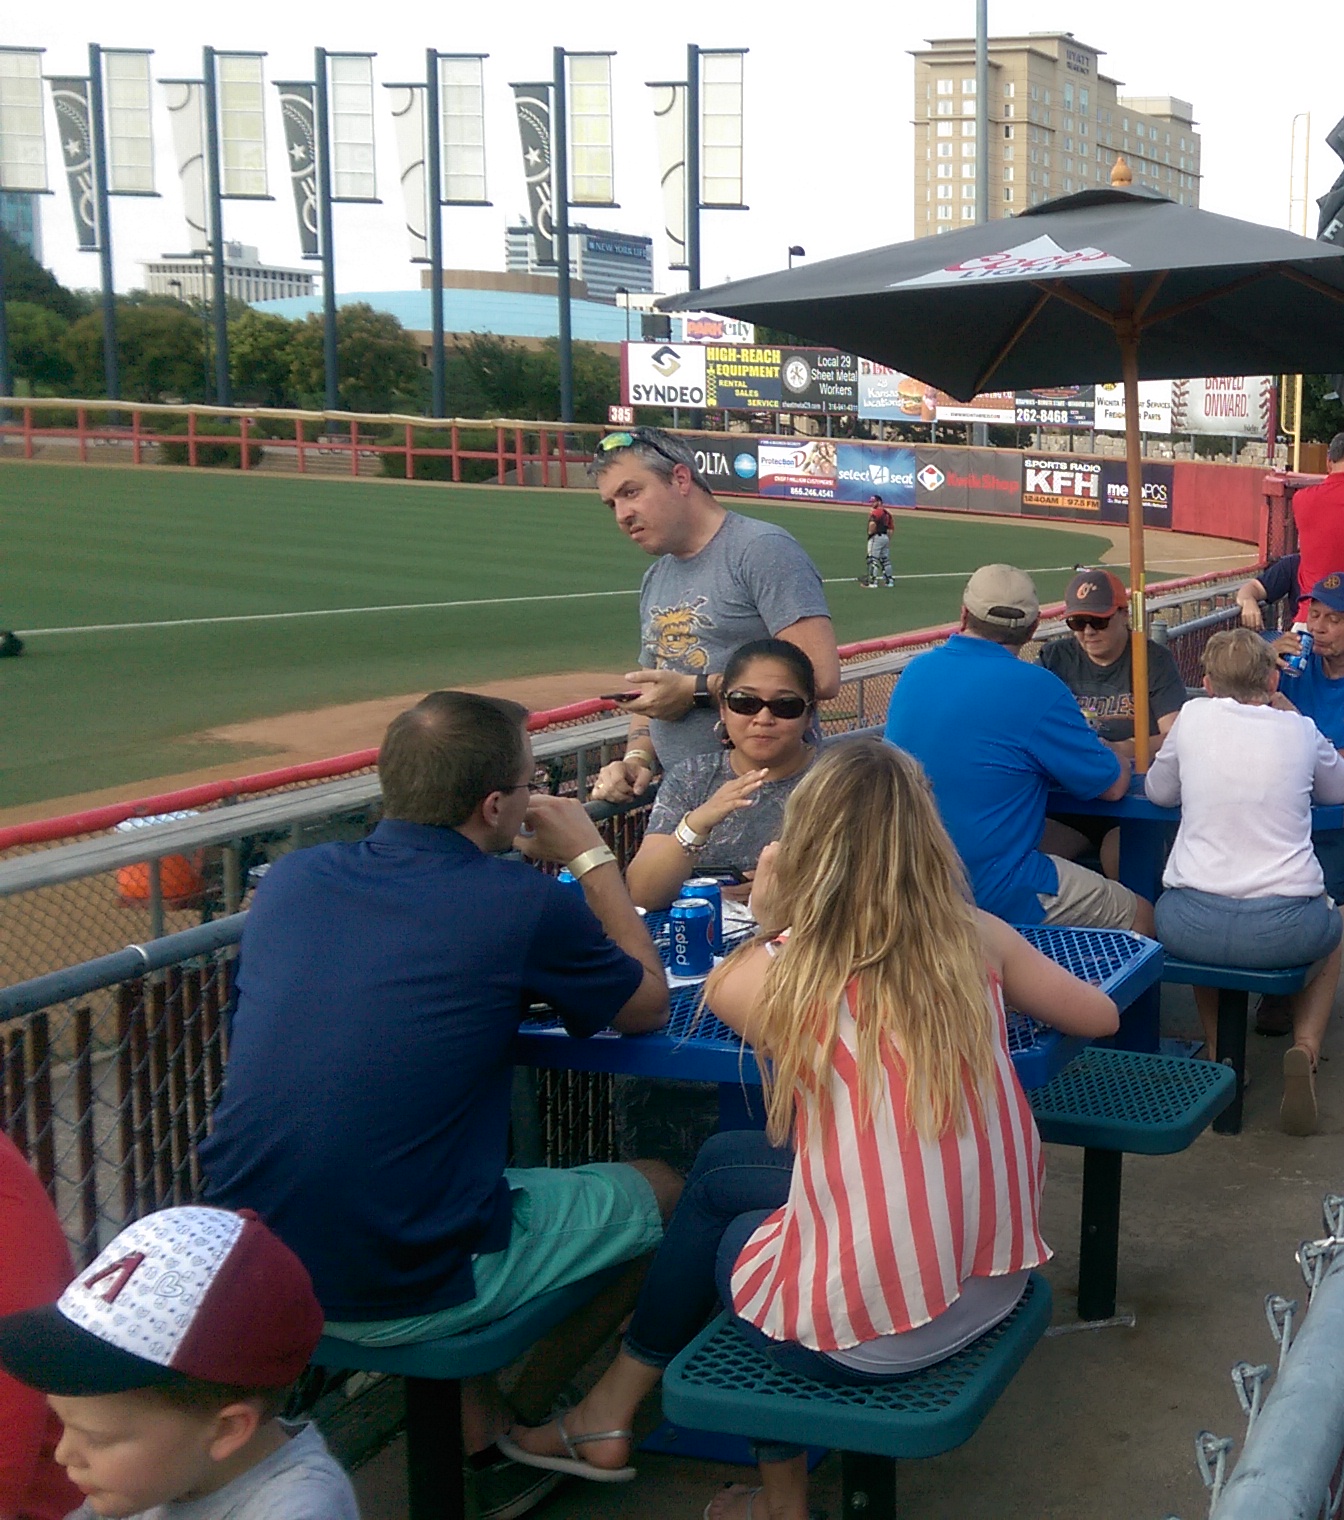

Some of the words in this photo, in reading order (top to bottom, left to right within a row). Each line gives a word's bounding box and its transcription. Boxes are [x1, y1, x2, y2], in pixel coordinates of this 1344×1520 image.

[1066, 49, 1089, 67] HYATT
[595, 241, 613, 252] NEW
[614, 244, 632, 255] YORK
[944, 251, 1110, 272] Coors
[958, 264, 1067, 279] LIGHT
[706, 347, 781, 364] HIGH-REACH
[817, 354, 839, 368] Local
[840, 355, 852, 369] 29
[716, 364, 780, 379] EQUIPMENT
[811, 368, 835, 382] Sheet
[836, 369, 858, 382] Metal
[718, 379, 748, 388] RENTAL
[818, 382, 853, 396] Workers
[632, 383, 704, 404] SYNDEO
[734, 389, 759, 397] SALES
[747, 399, 779, 408] SERVICE
[610, 407, 631, 423] 385
[1016, 407, 1068, 424] 262-8468
[761, 456, 795, 467] Protection
[1024, 459, 1068, 471] SPORTS
[1069, 461, 1101, 473] RADIO
[890, 471, 914, 485] seat
[1026, 468, 1100, 497] KFH
[1107, 483, 1167, 501] mePCS
[1067, 498, 1086, 508] 97.5
[1086, 500, 1100, 509] FM
[672, 920, 690, 966] pepsi
